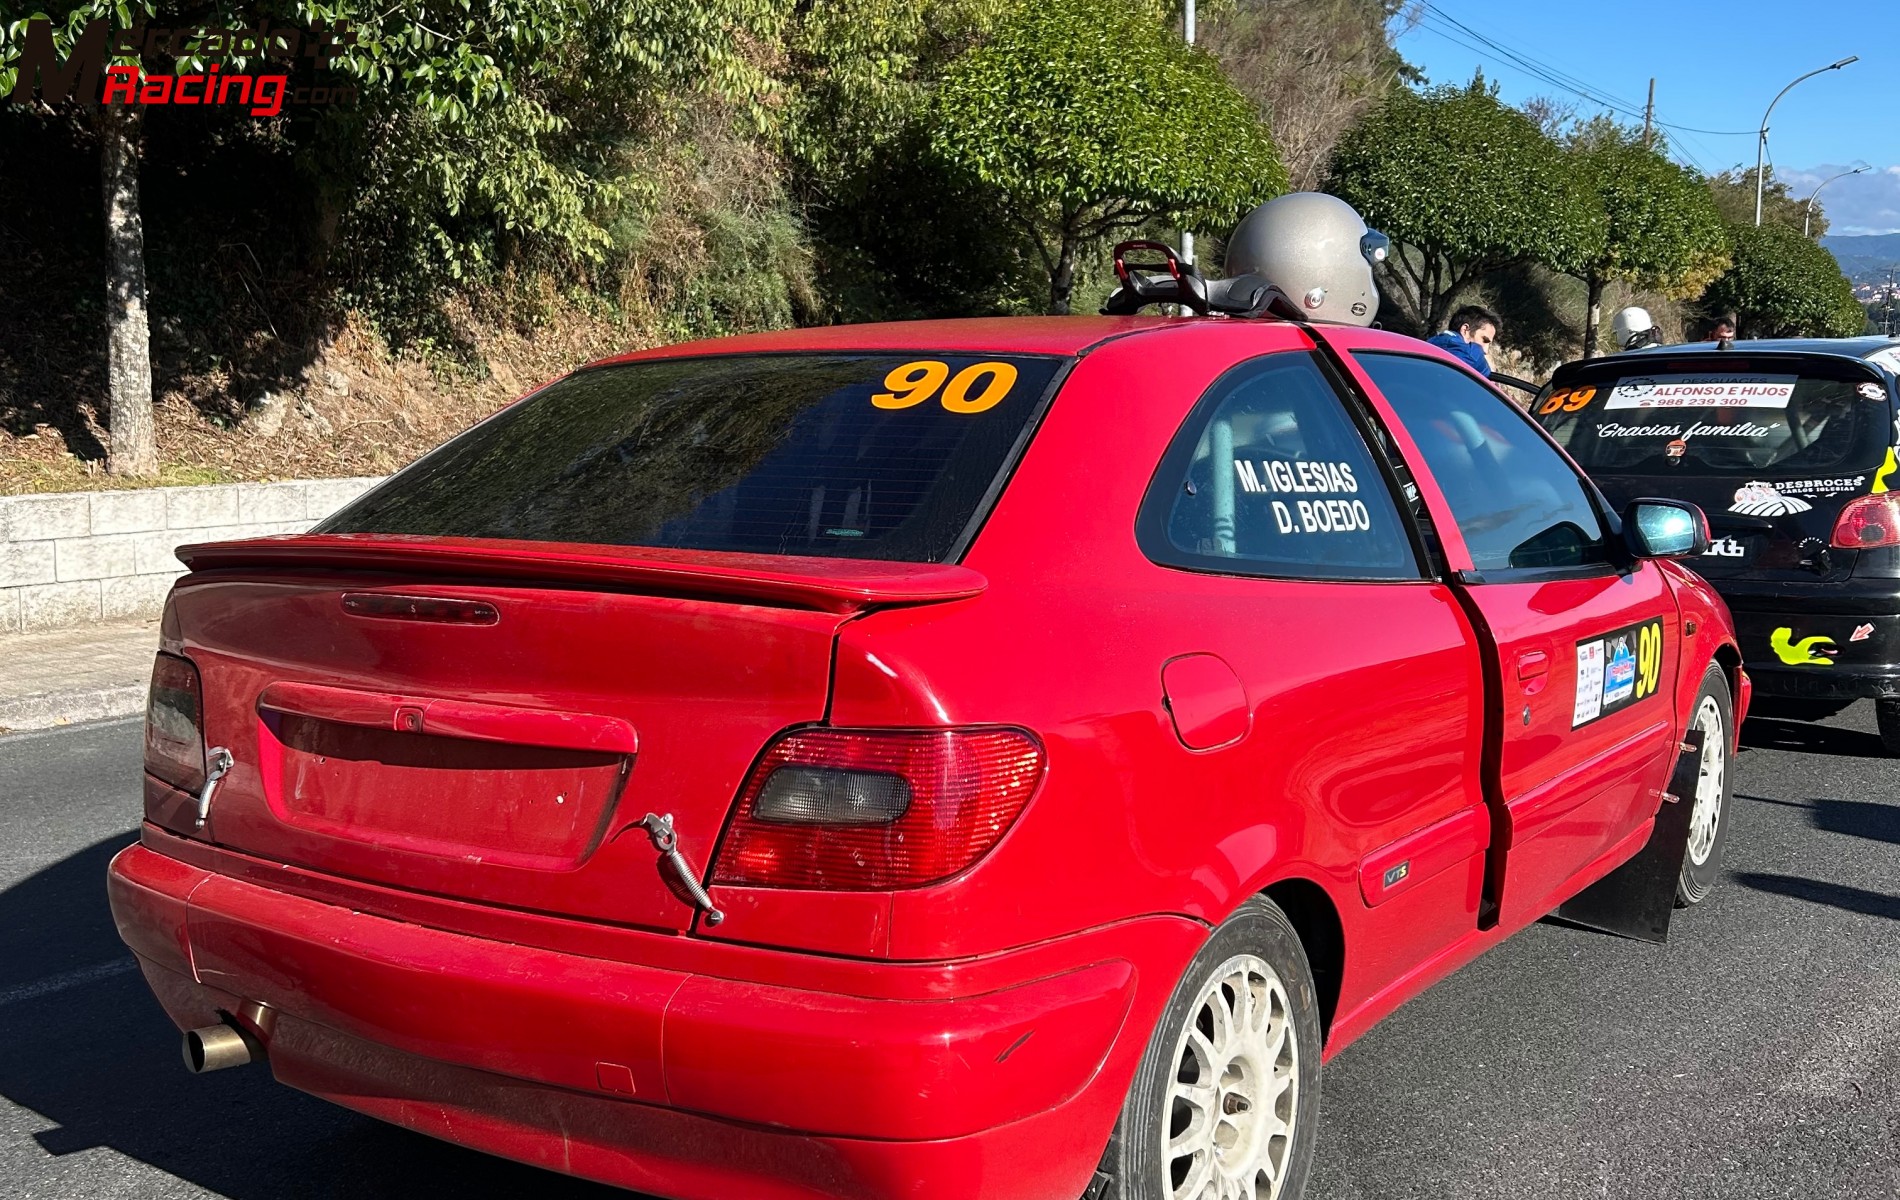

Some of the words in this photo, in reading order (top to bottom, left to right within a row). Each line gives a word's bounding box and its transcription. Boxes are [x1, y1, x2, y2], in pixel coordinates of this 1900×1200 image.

[871, 360, 1018, 414] 90
[1538, 385, 1597, 415] 89
[1653, 386, 1725, 396] ALFONSO
[1728, 386, 1739, 395] E
[1741, 387, 1790, 397] HIJOS
[1719, 398, 1748, 406] 300
[1234, 459, 1267, 493] M.
[1263, 460, 1358, 493] IGLESIAS
[1775, 479, 1863, 490] DESBROCES
[1272, 501, 1300, 534] D.
[1297, 500, 1371, 533] BOEDO
[1636, 622, 1661, 699] 90
[1387, 865, 1407, 883] VTS
